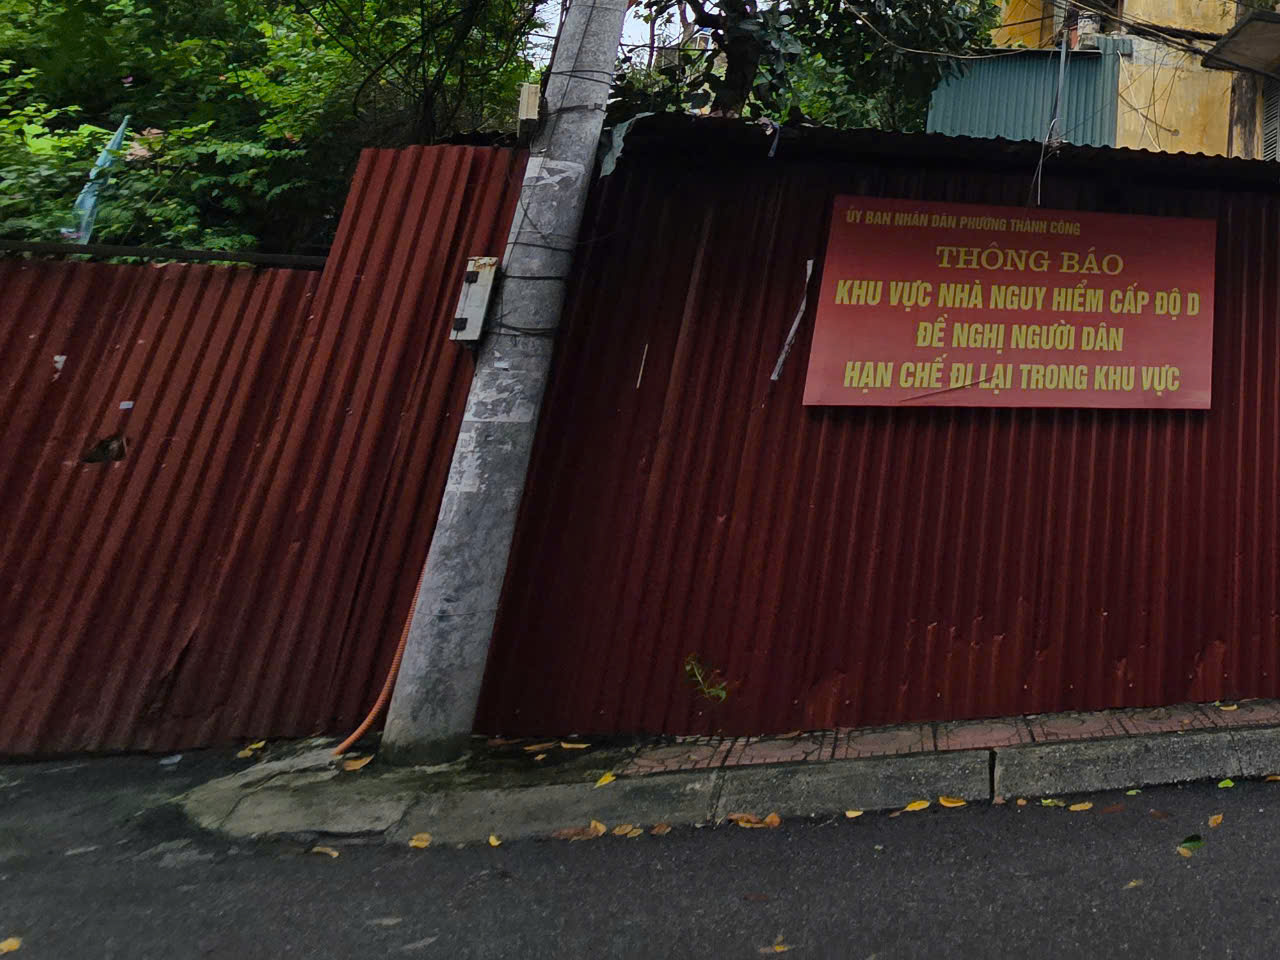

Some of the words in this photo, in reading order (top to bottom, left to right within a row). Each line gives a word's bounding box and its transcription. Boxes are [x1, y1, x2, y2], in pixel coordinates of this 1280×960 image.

[865, 210, 891, 225] BAN
[894, 210, 928, 227] NHÂN
[932, 213, 957, 228] DÂN
[959, 212, 1007, 231] PHƯỜNG
[1010, 216, 1048, 233] THÀNH
[1050, 218, 1081, 236] CÔNG
[936, 241, 1051, 272] THÔNG
[1059, 246, 1125, 276] BÁO
[835, 280, 883, 305] KHU
[889, 279, 932, 312] VỰC
[937, 280, 983, 309] NHÀ
[989, 284, 1047, 311] NGUY
[1052, 279, 1104, 313] HIỂM
[1109, 282, 1150, 314] CẤP
[1155, 287, 1181, 321] ĐỘ
[1187, 292, 1200, 316] D
[915, 313, 948, 348] ĐỀ
[951, 322, 1005, 354] NGHỊ
[1010, 319, 1076, 351] NGƯỜI
[1081, 321, 1124, 352] DÂN
[843, 361, 894, 394] HẠN
[899, 353, 948, 388] CHẾ
[950, 362, 974, 389] ĐI
[978, 363, 1013, 395] LẠI
[1019, 364, 1088, 390] TRONG
[1094, 365, 1135, 391] KHU
[1141, 364, 1180, 397] VỰC
